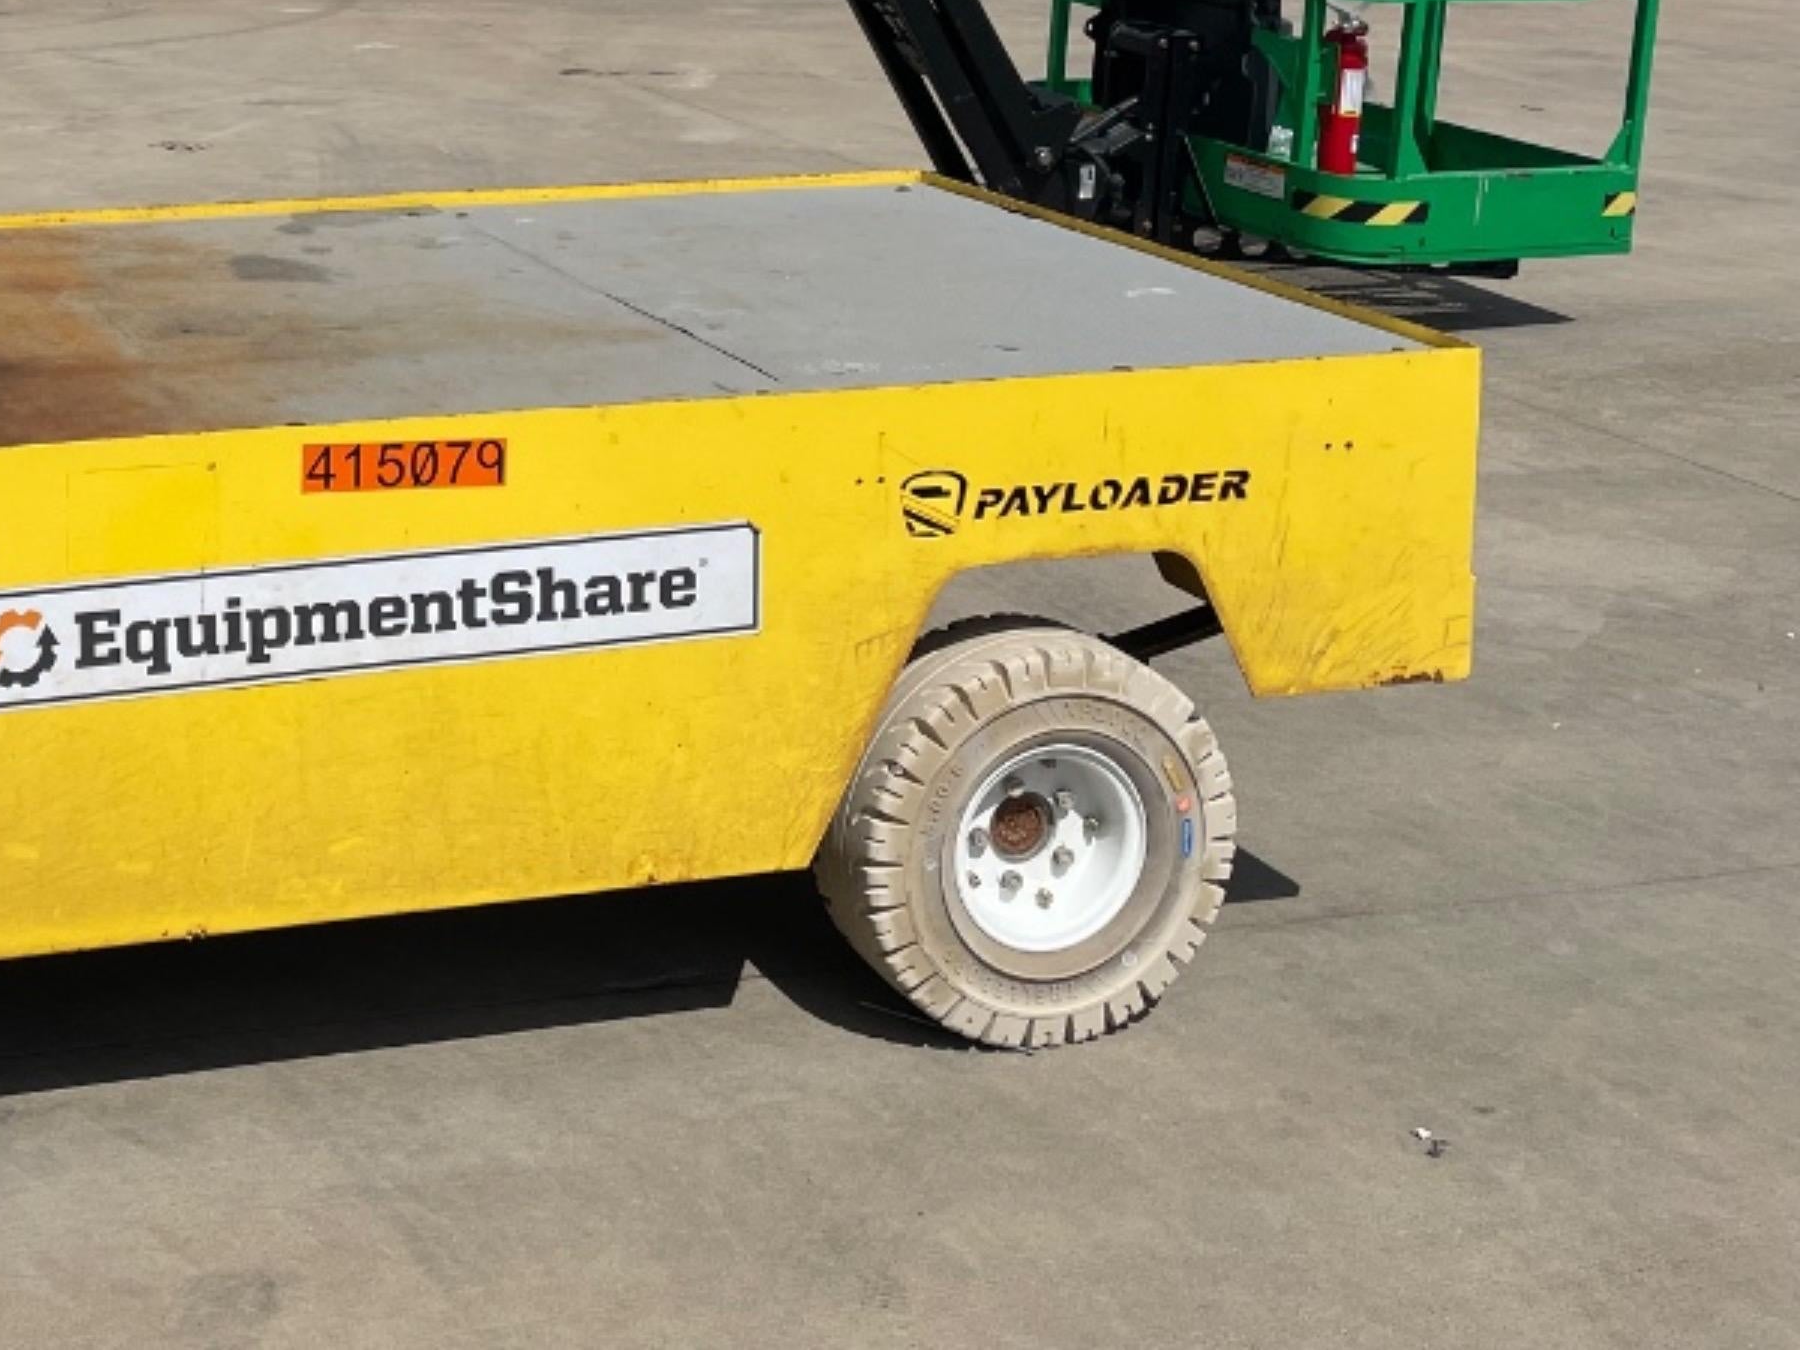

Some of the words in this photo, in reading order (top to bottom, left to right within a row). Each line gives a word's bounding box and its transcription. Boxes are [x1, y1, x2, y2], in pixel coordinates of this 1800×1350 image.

[304, 440, 505, 489] 415079
[973, 470, 1251, 520] PAYLOADER
[74, 564, 698, 675] EquipmentShare
